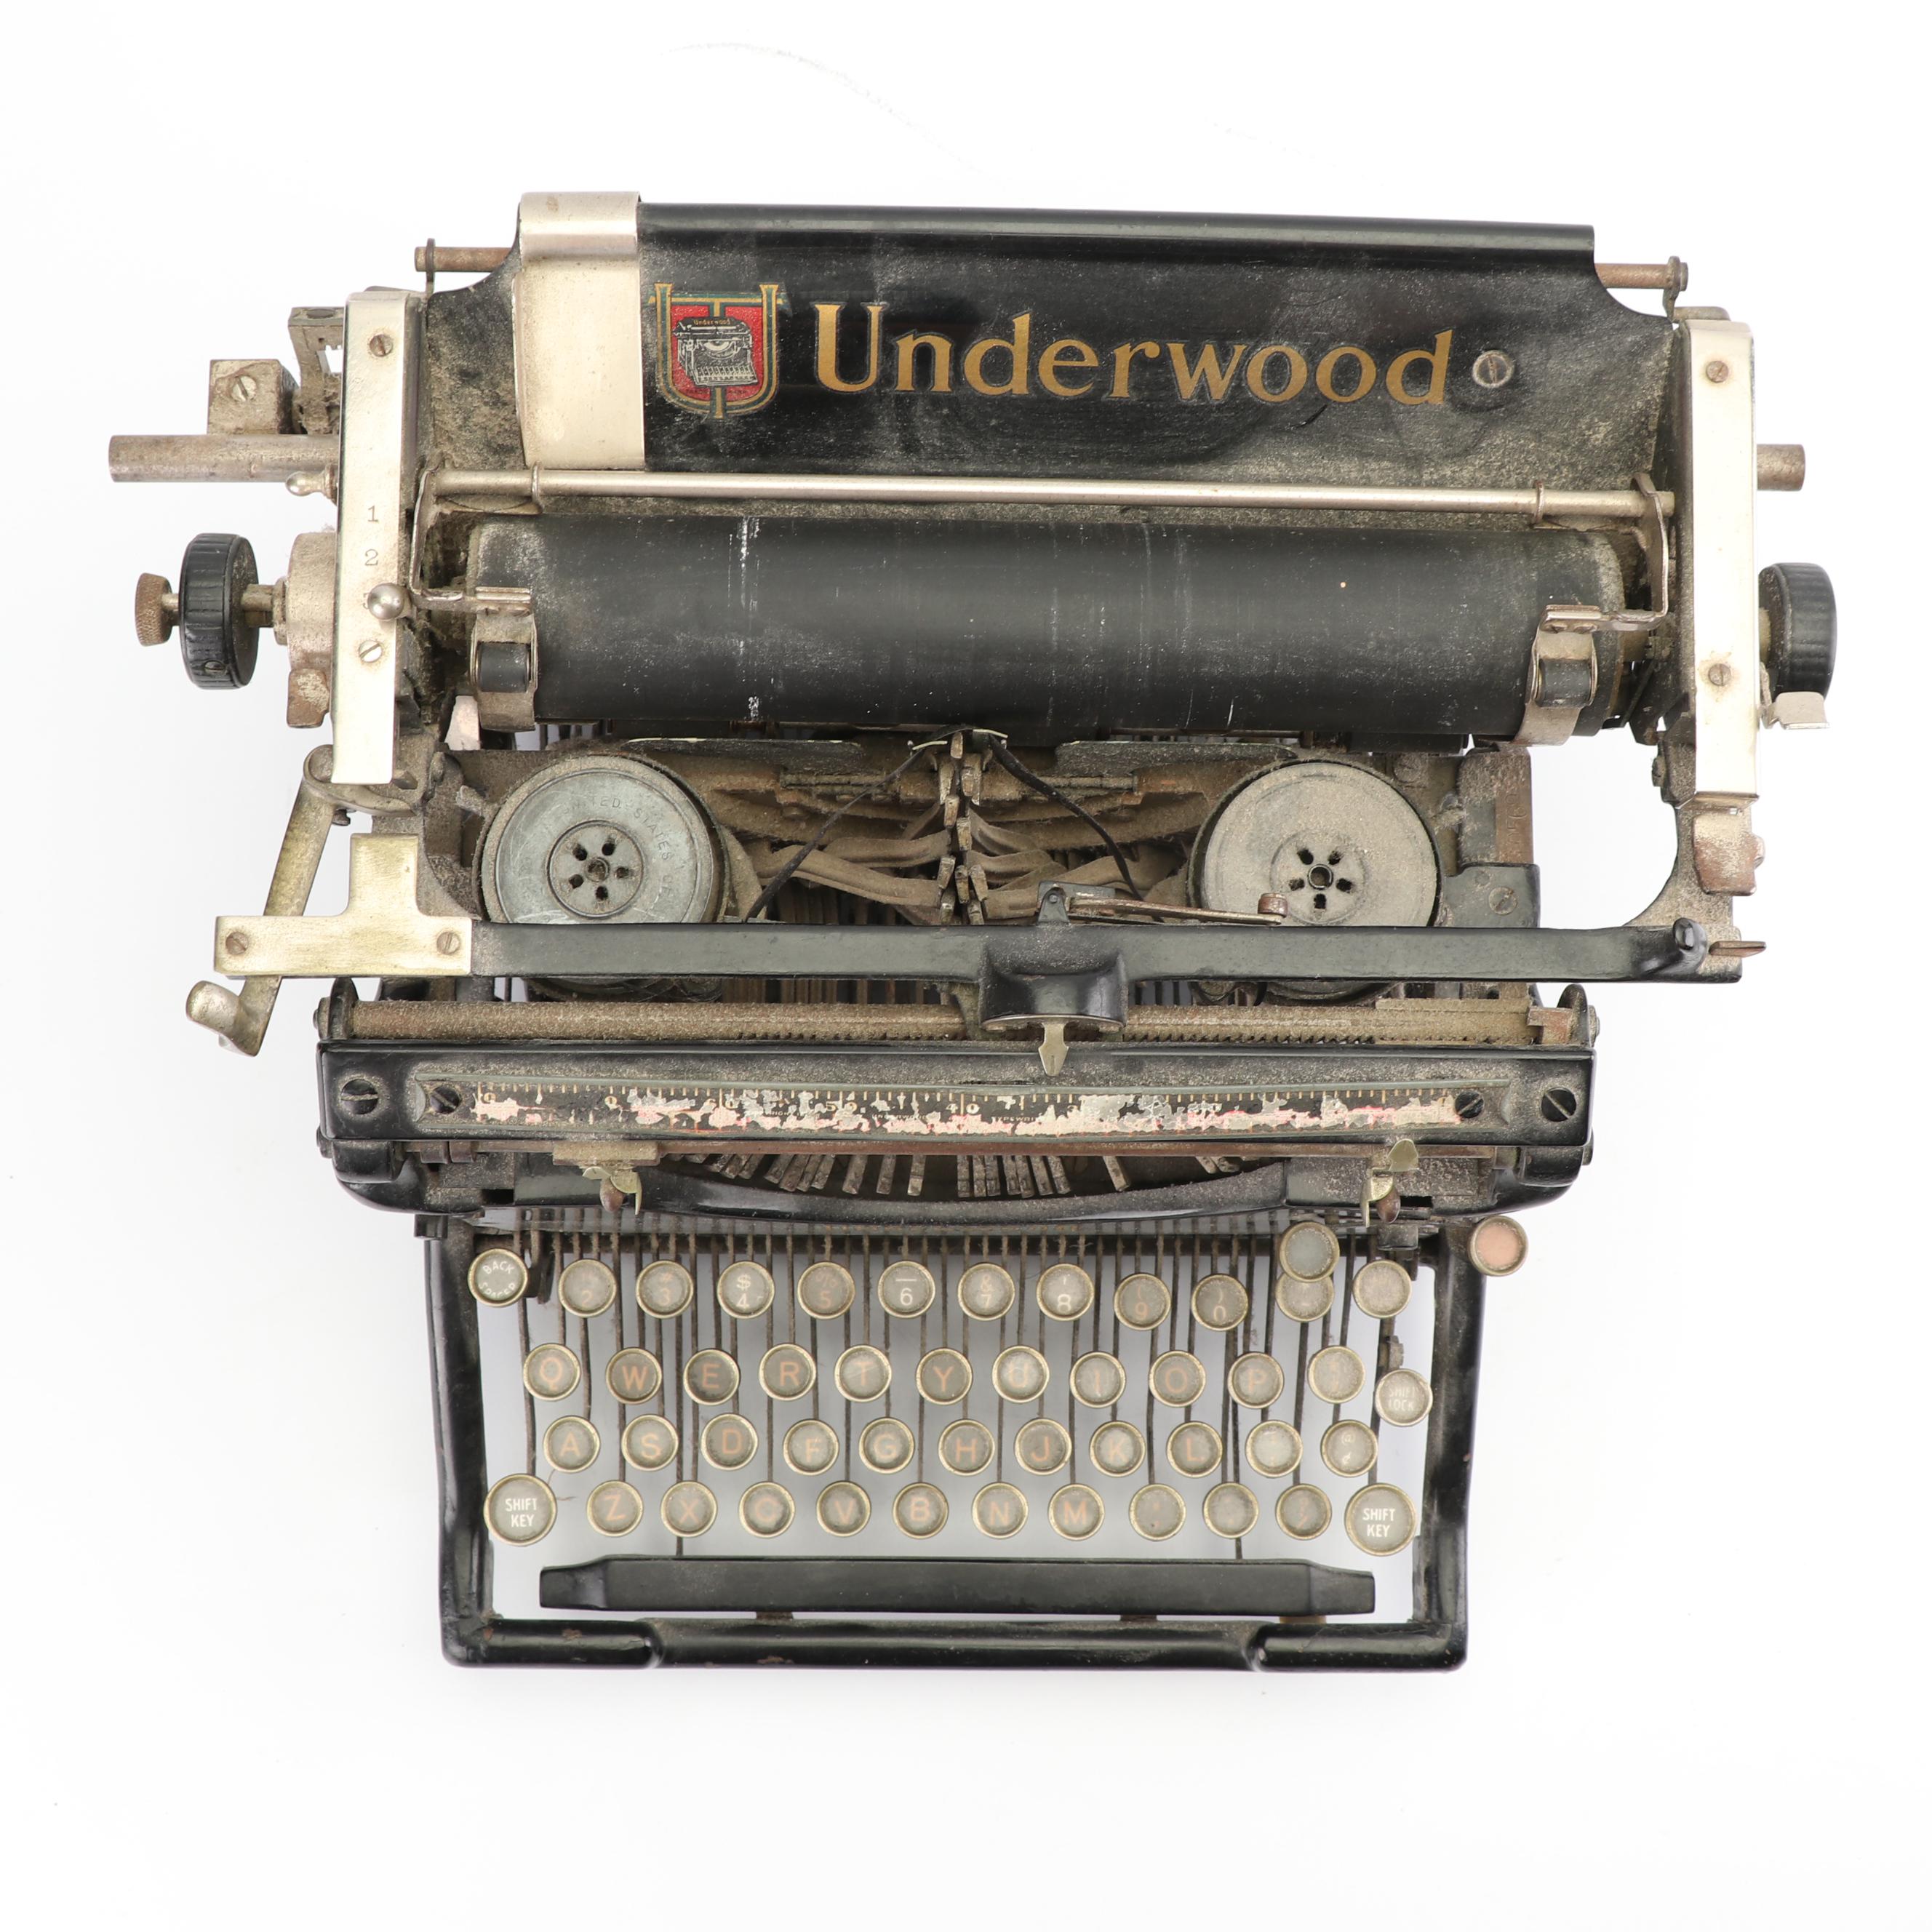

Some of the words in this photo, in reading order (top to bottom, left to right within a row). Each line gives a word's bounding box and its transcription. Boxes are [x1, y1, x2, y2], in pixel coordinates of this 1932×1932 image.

[813, 303, 1453, 405] Underwood
[368, 505, 380, 522] 1
[364, 549, 379, 566] 2
[482, 1261, 515, 1275] BACK
[736, 1274, 751, 1290] $
[660, 1288, 670, 1306] 3
[736, 1293, 750, 1309] 4
[820, 1290, 832, 1309] 5
[900, 1288, 913, 1306] 6
[981, 1293, 992, 1310] 7
[1058, 1293, 1071, 1312] 8
[1135, 1301, 1149, 1319] 9
[539, 1357, 563, 1391] Q
[622, 1365, 647, 1391] W
[702, 1364, 721, 1389] E
[779, 1361, 799, 1386] R
[854, 1361, 872, 1386] T
[933, 1365, 954, 1392] Y
[1009, 1360, 1028, 1388] U
[1165, 1366, 1188, 1394] O
[1247, 1368, 1267, 1394] P
[559, 1431, 580, 1457] A
[641, 1432, 661, 1460] S
[722, 1428, 743, 1454] D
[805, 1437, 822, 1463] F
[873, 1432, 898, 1462] G
[955, 1437, 978, 1463] H
[1031, 1436, 1050, 1463] J
[1109, 1437, 1127, 1462] K
[1186, 1437, 1204, 1462] L
[505, 1498, 538, 1512] SHIFT
[604, 1494, 627, 1522] Z
[679, 1498, 700, 1525] X
[834, 1499, 855, 1525] V
[911, 1496, 931, 1522] B
[989, 1501, 1010, 1526] N
[1063, 1501, 1087, 1526] M
[1362, 1508, 1396, 1522] SHIFT
[511, 1514, 535, 1528] KEY
[1367, 1523, 1391, 1538] KEY
